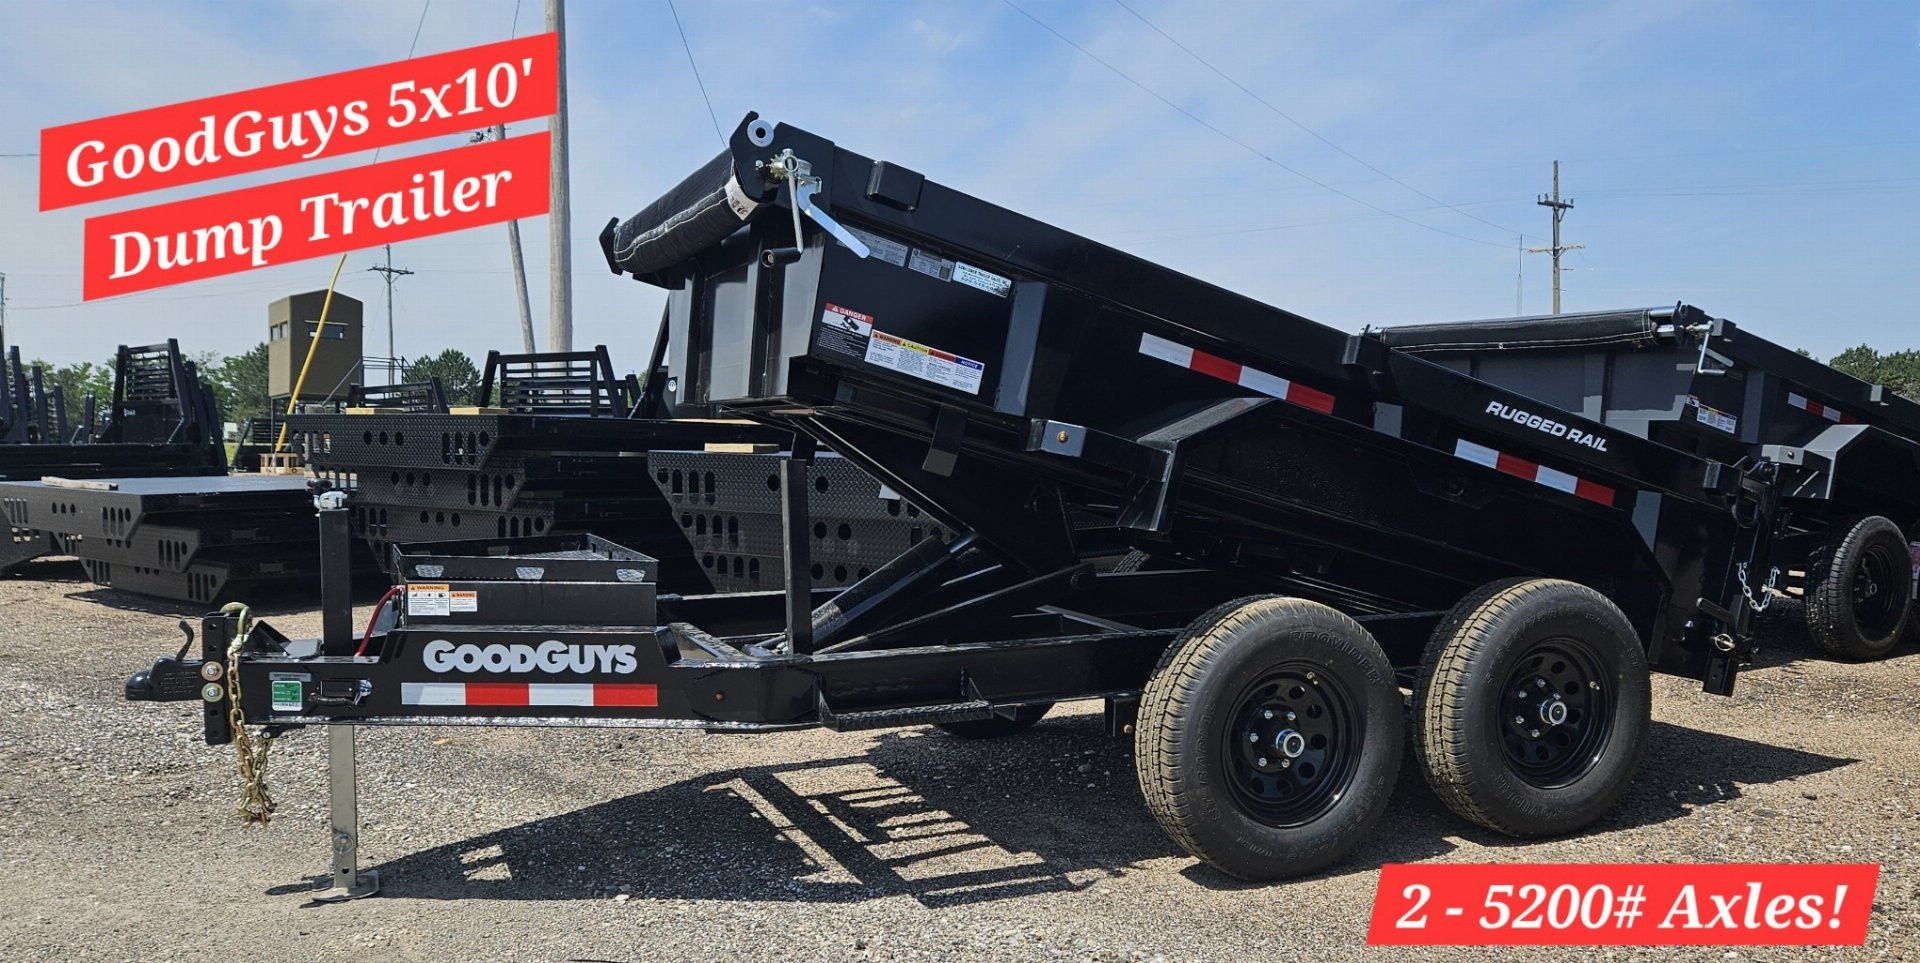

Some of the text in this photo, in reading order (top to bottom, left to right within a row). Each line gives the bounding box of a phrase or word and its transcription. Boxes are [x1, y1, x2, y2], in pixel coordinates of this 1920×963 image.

[839, 308, 867, 321] DANGER
[907, 343, 928, 353] CAUTION
[960, 360, 978, 369] NOTICE
[1485, 401, 1608, 452] RUGGED RAIL
[1290, 630, 1382, 684] PROVIDER
